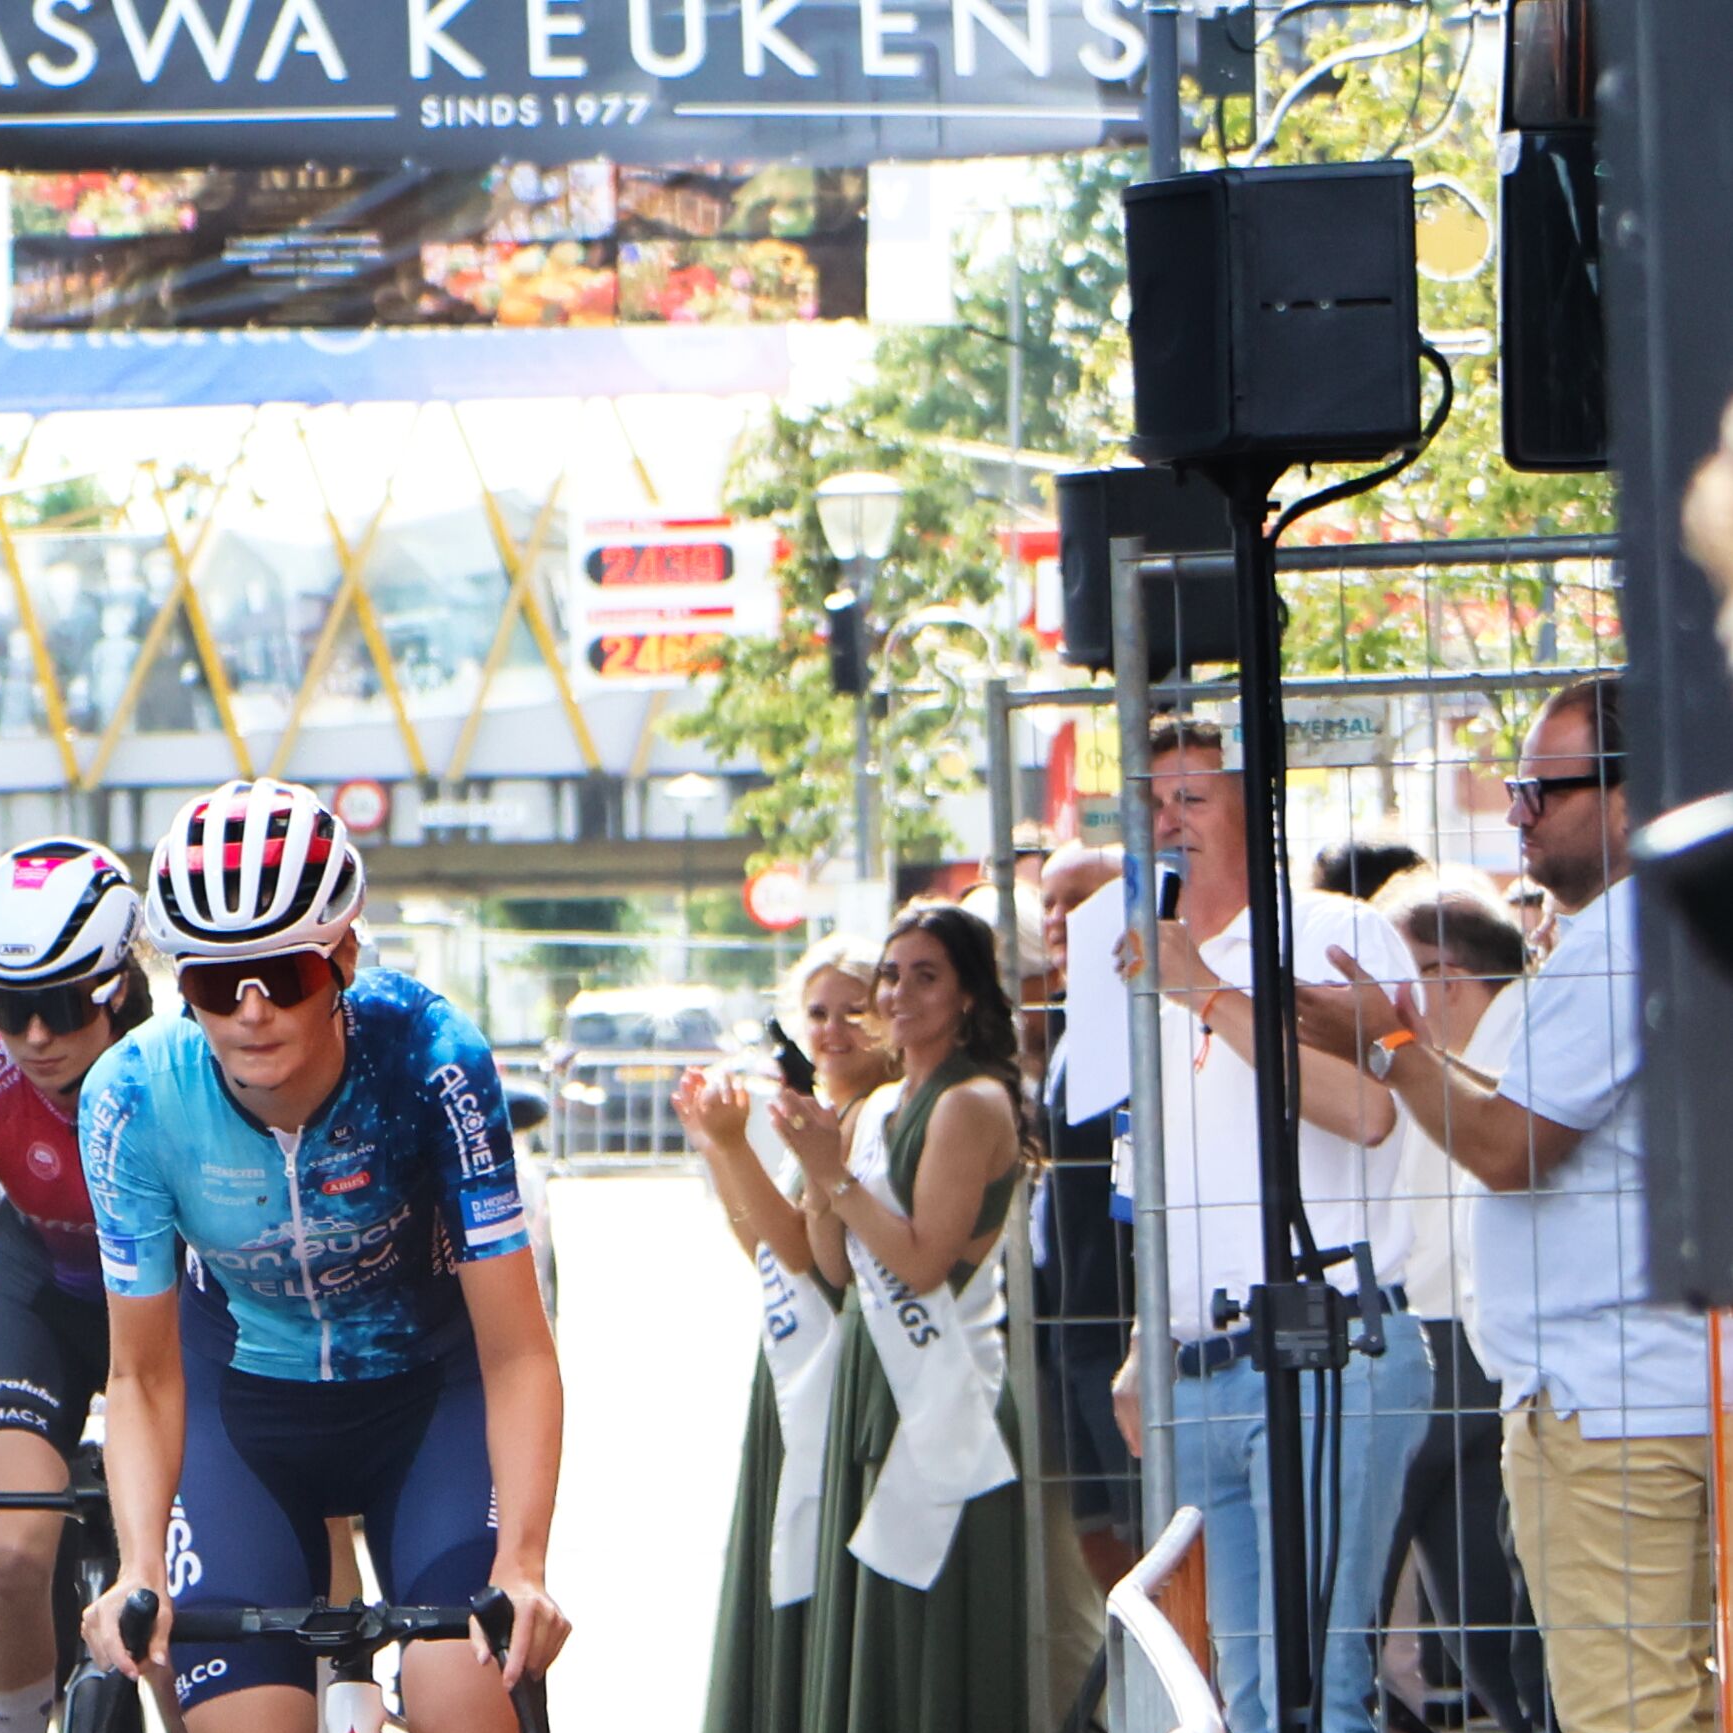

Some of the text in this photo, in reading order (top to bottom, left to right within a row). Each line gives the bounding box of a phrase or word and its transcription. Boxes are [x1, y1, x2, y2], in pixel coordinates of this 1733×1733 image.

[408, 0, 1148, 82] KEUKENS
[420, 94, 653, 128] SINDS 1977
[328, 1174, 366, 1193] ABUS
[175, 1657, 228, 1696] ELCO
